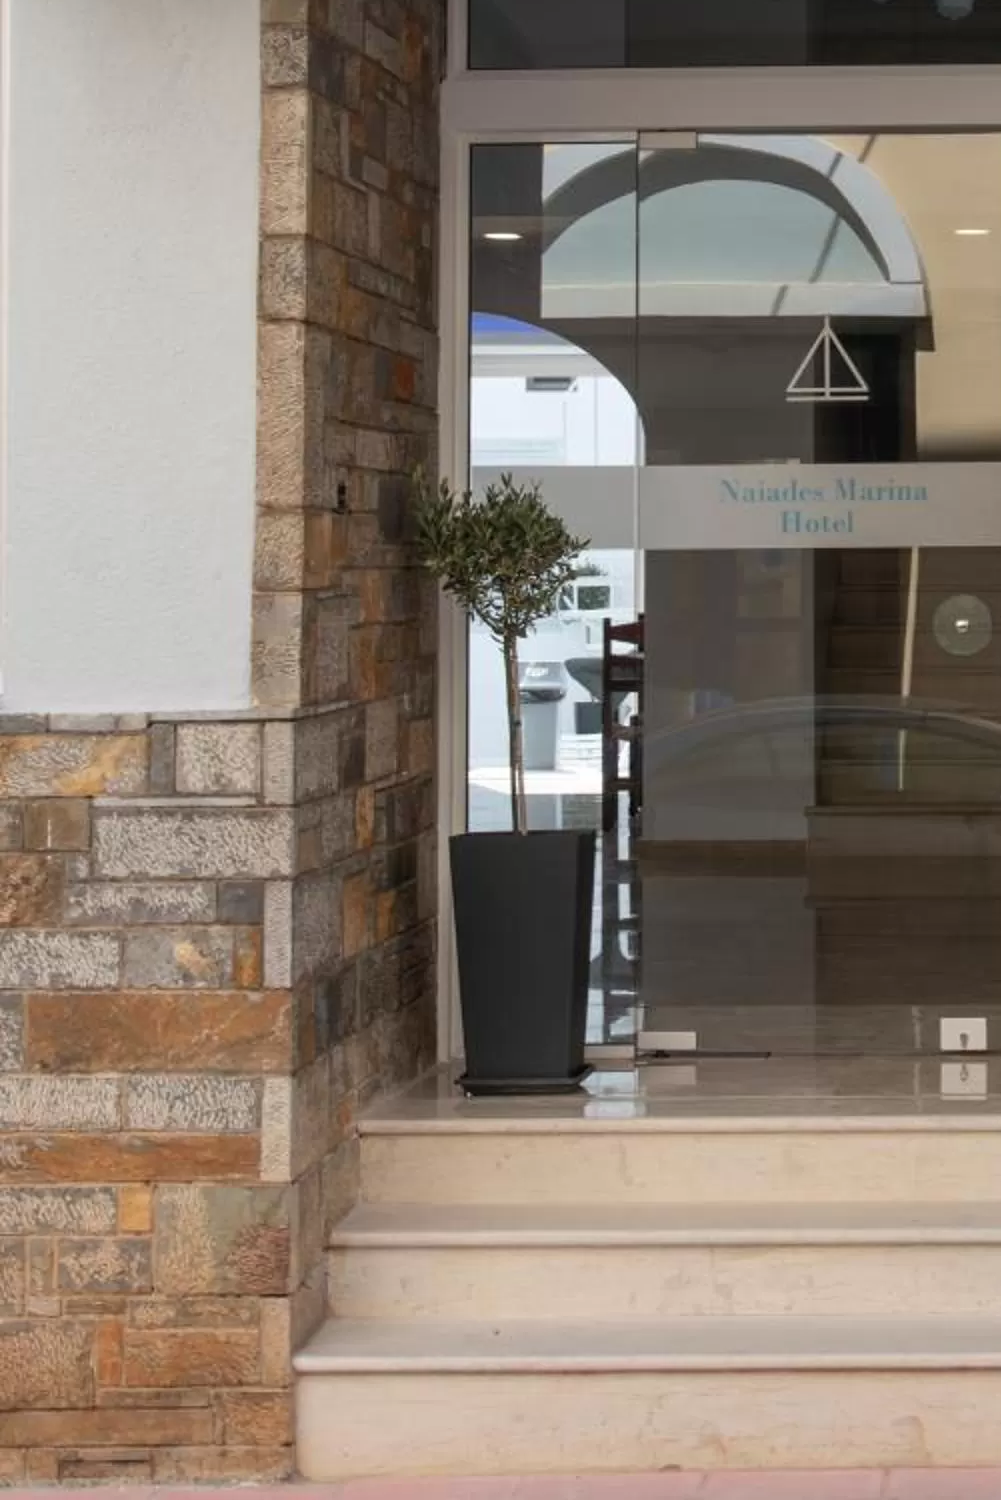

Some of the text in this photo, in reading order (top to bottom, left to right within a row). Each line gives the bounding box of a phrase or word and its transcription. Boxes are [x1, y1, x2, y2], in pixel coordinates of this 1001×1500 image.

[720, 477, 928, 502] Naiades Marina
[781, 510, 854, 533] Hotel
